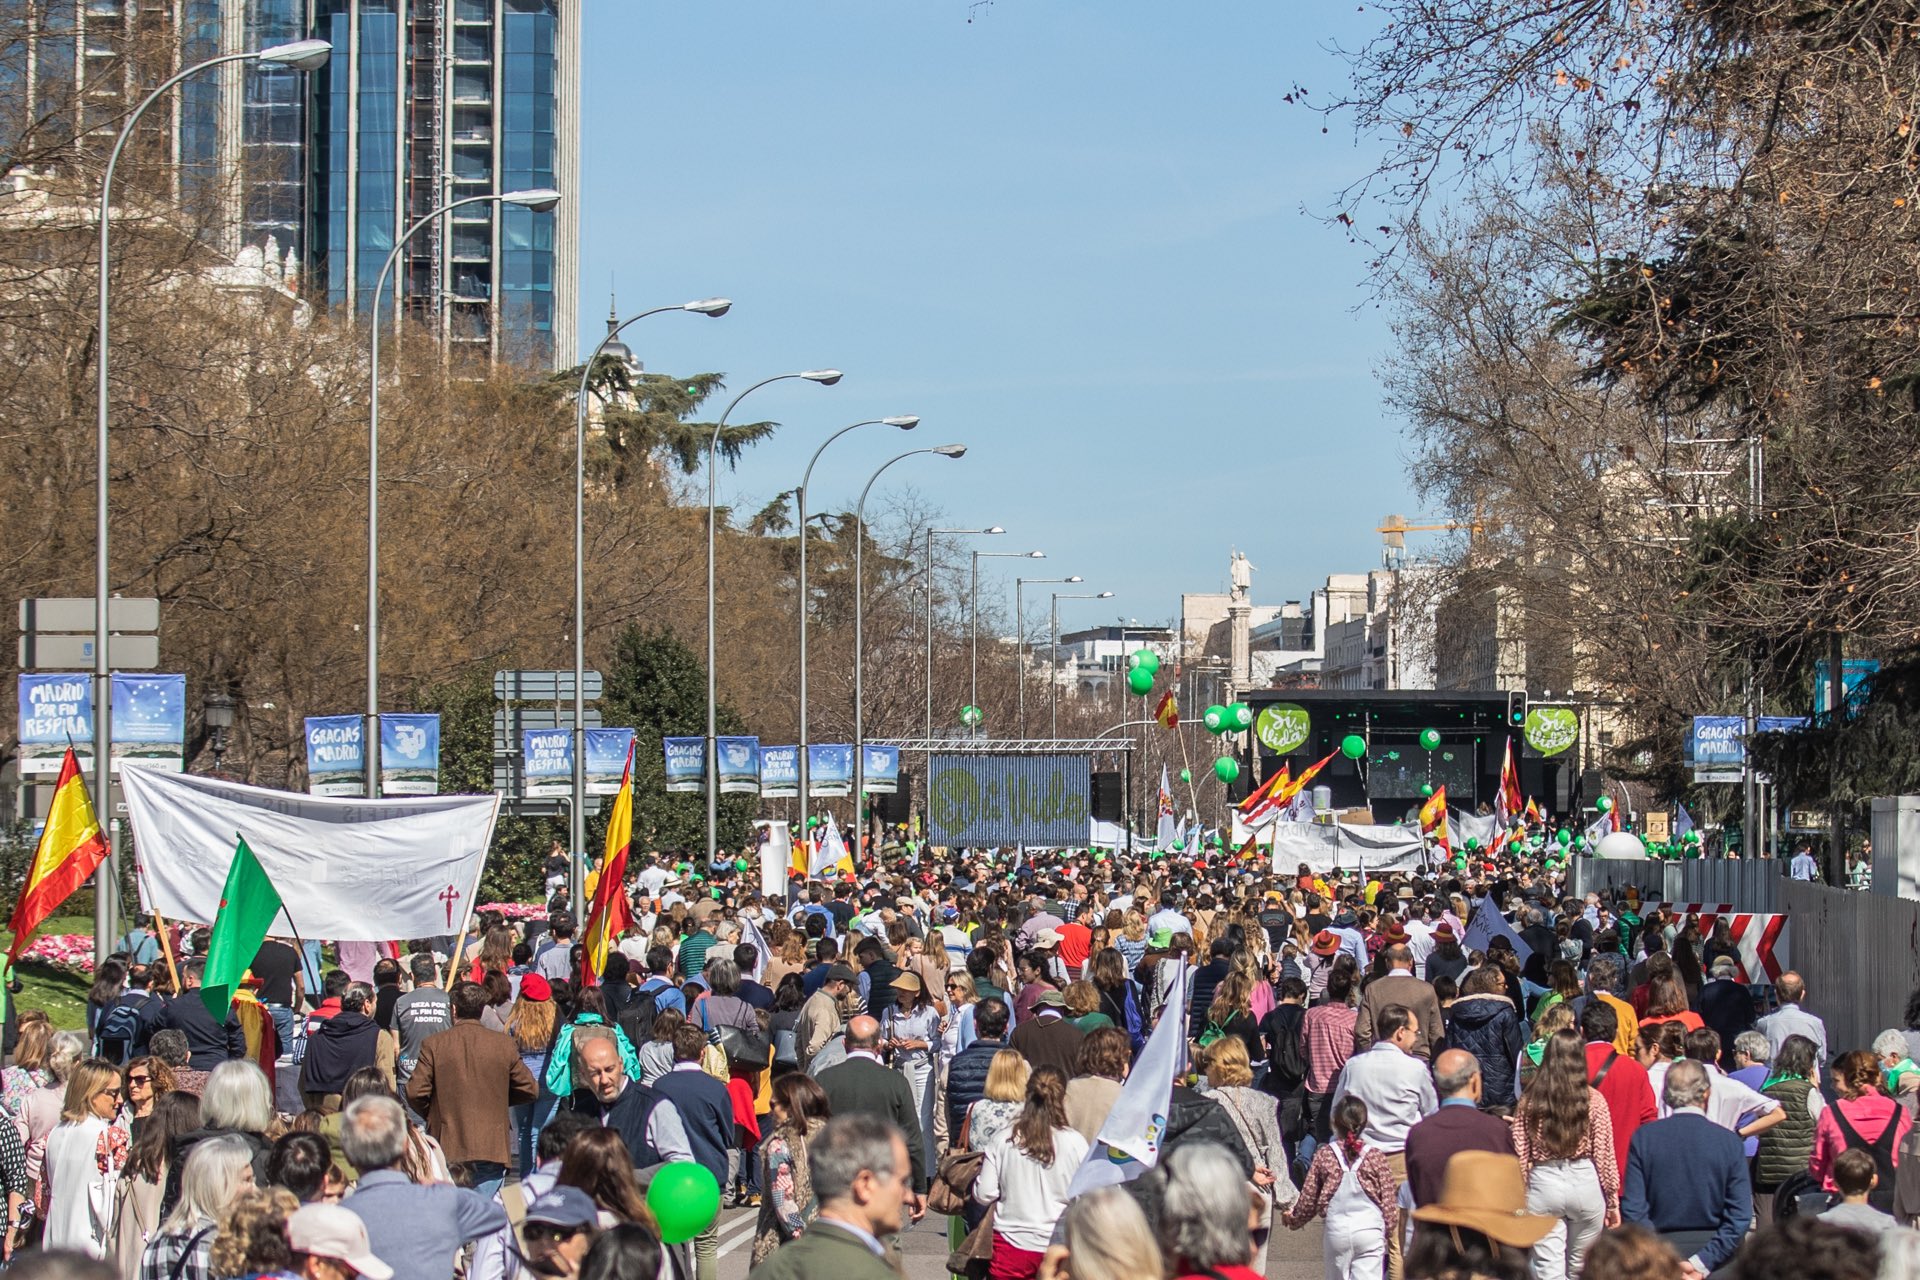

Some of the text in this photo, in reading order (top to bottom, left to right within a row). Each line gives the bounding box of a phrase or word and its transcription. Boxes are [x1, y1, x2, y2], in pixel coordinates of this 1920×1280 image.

[30, 683, 85, 704] MADRID
[35, 702, 79, 718] POR FIN
[26, 717, 88, 737] RESPIRA
[1696, 725, 1740, 740] GRACIAS
[309, 726, 361, 745] GRACIAS
[531, 735, 569, 749] MADRID
[313, 744, 360, 764] MADRID
[534, 748, 565, 759] POR FIN
[667, 744, 703, 757] GRACIAS
[1700, 740, 1739, 755] MADRID
[670, 756, 703, 769] MADRID
[765, 750, 795, 762] MADRID
[528, 758, 570, 773] RESPIRA
[763, 768, 796, 778] RESPIRA
